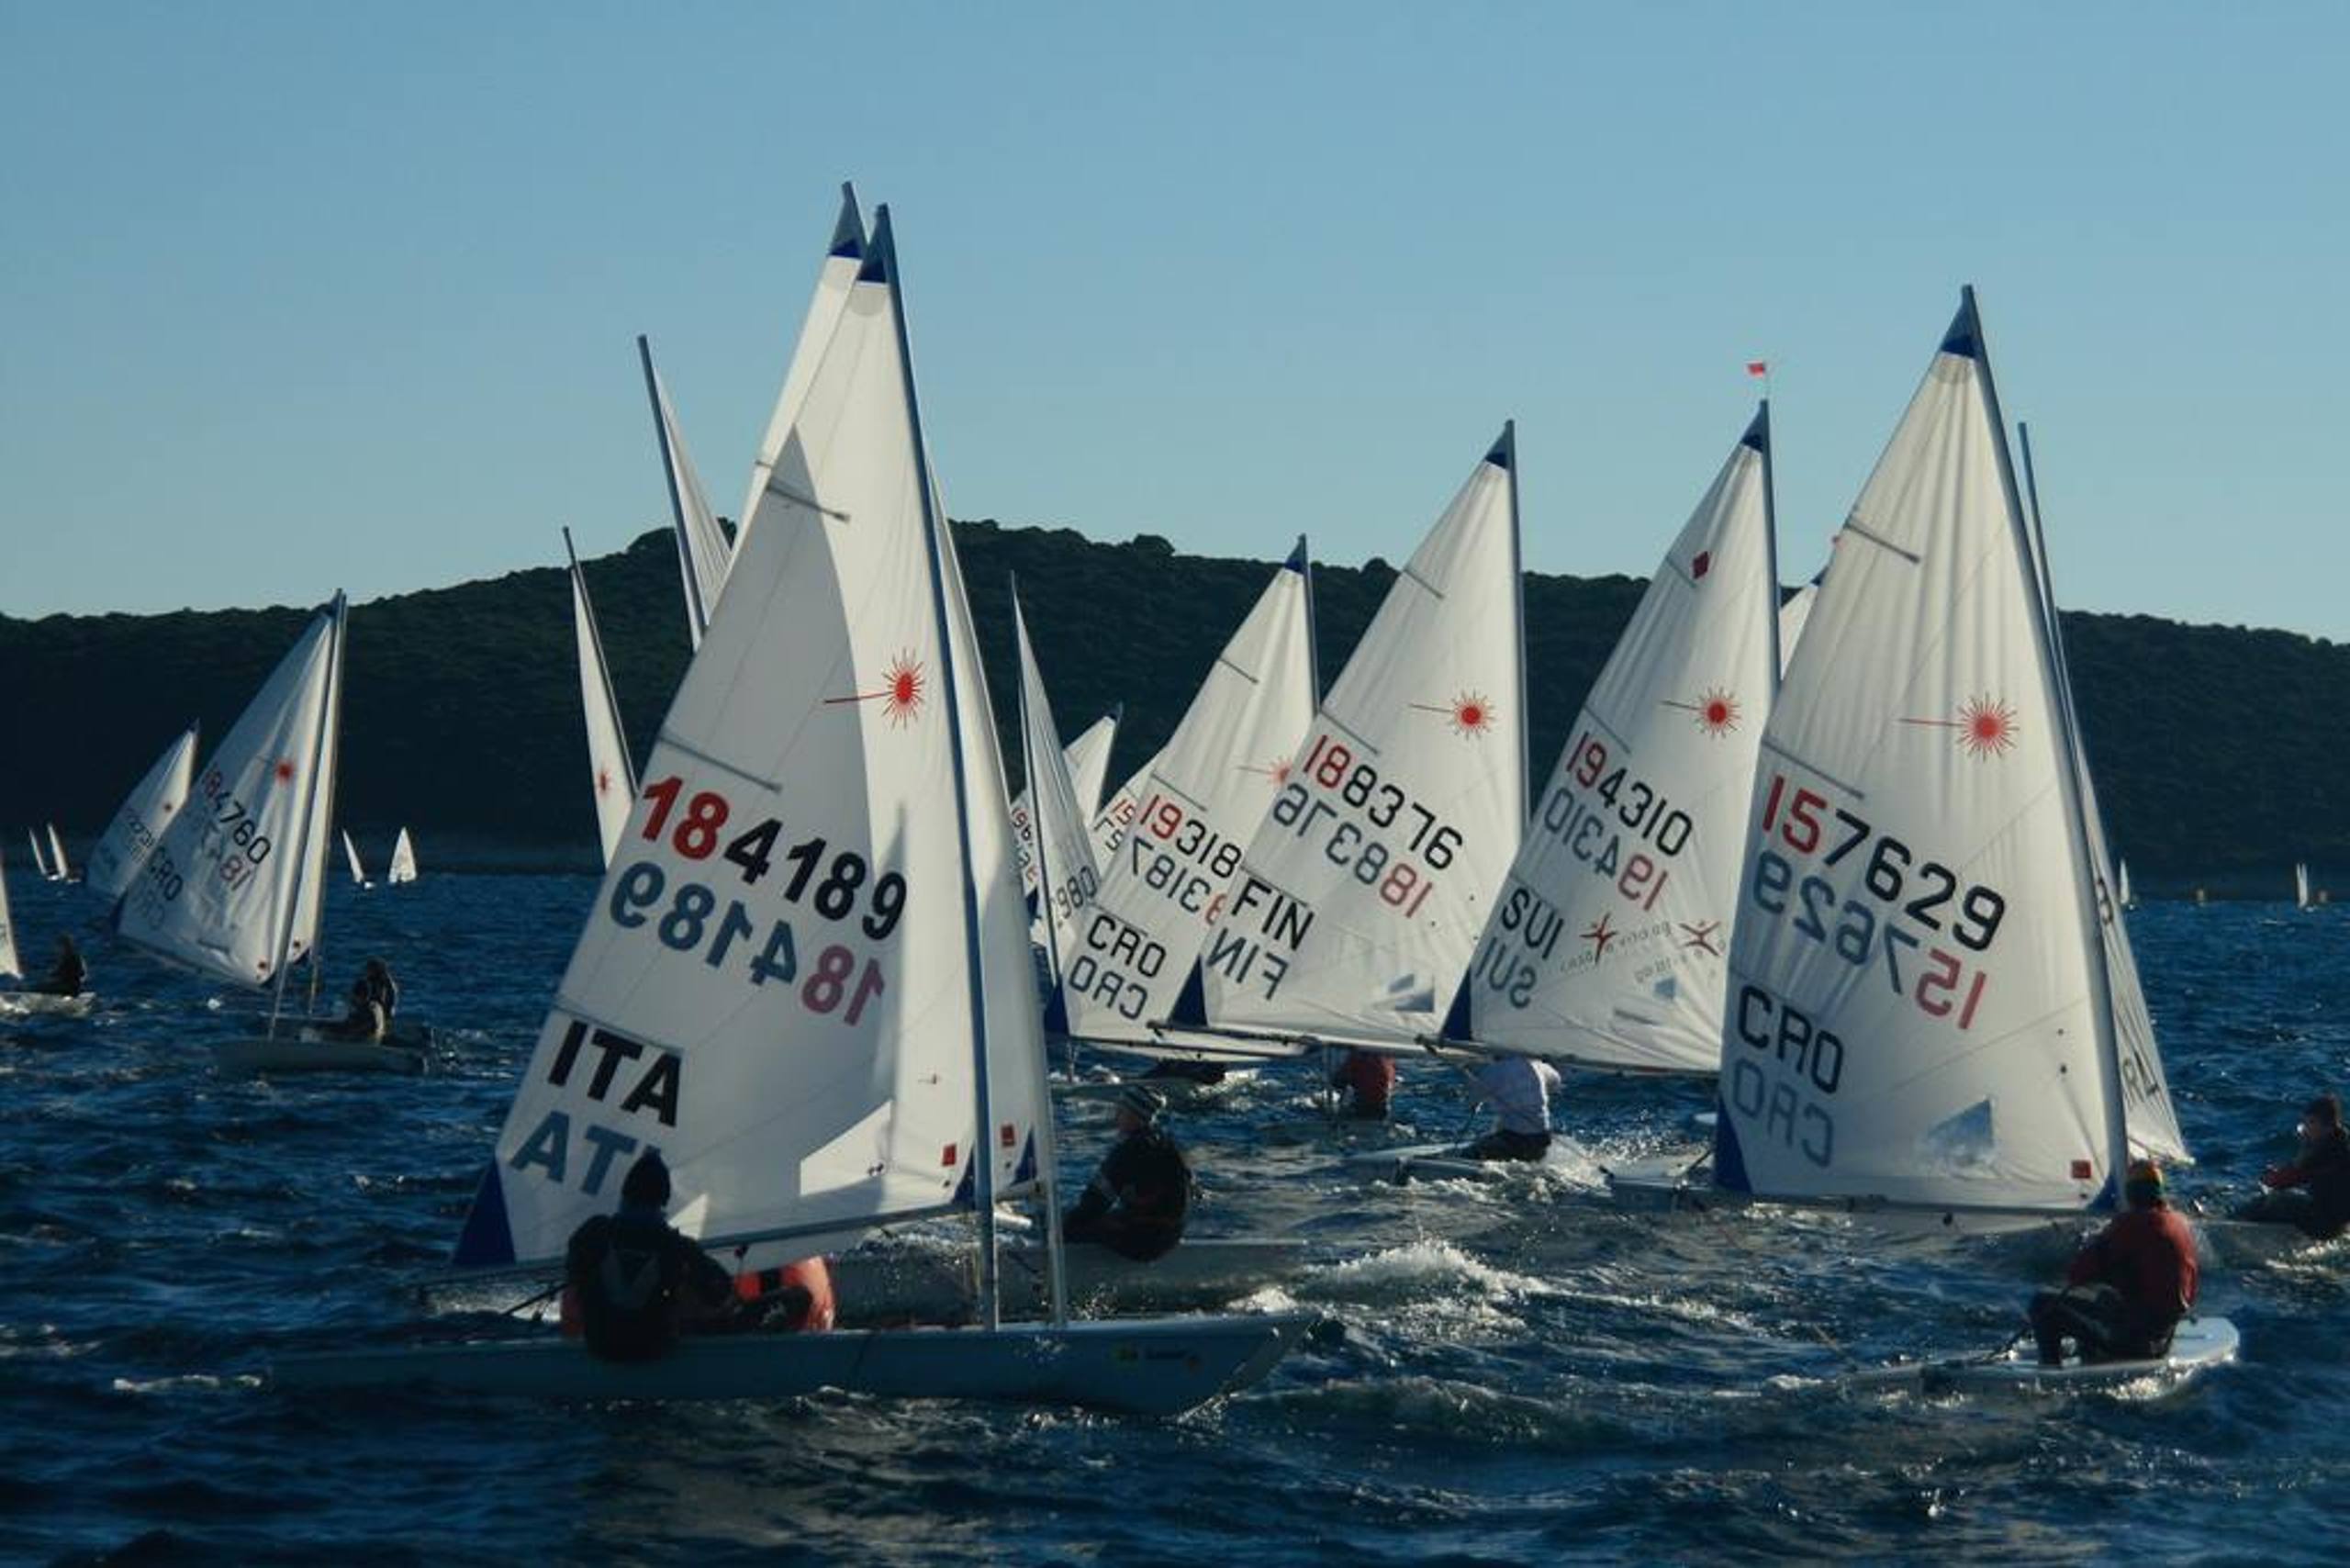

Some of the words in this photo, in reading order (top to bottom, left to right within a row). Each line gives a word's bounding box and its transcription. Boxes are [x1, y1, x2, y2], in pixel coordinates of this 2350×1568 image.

[1139, 794, 1243, 879] 19318
[1302, 734, 1464, 870] 188376
[1566, 732, 1693, 857] 194310
[642, 776, 908, 941] 184189
[1762, 775, 2006, 952] 157629
[1086, 915, 1168, 980] CRO
[1230, 879, 1315, 952] FIN
[1501, 887, 1564, 960] SUI
[547, 1019, 682, 1128] ITA
[1737, 985, 1844, 1096] CRO
